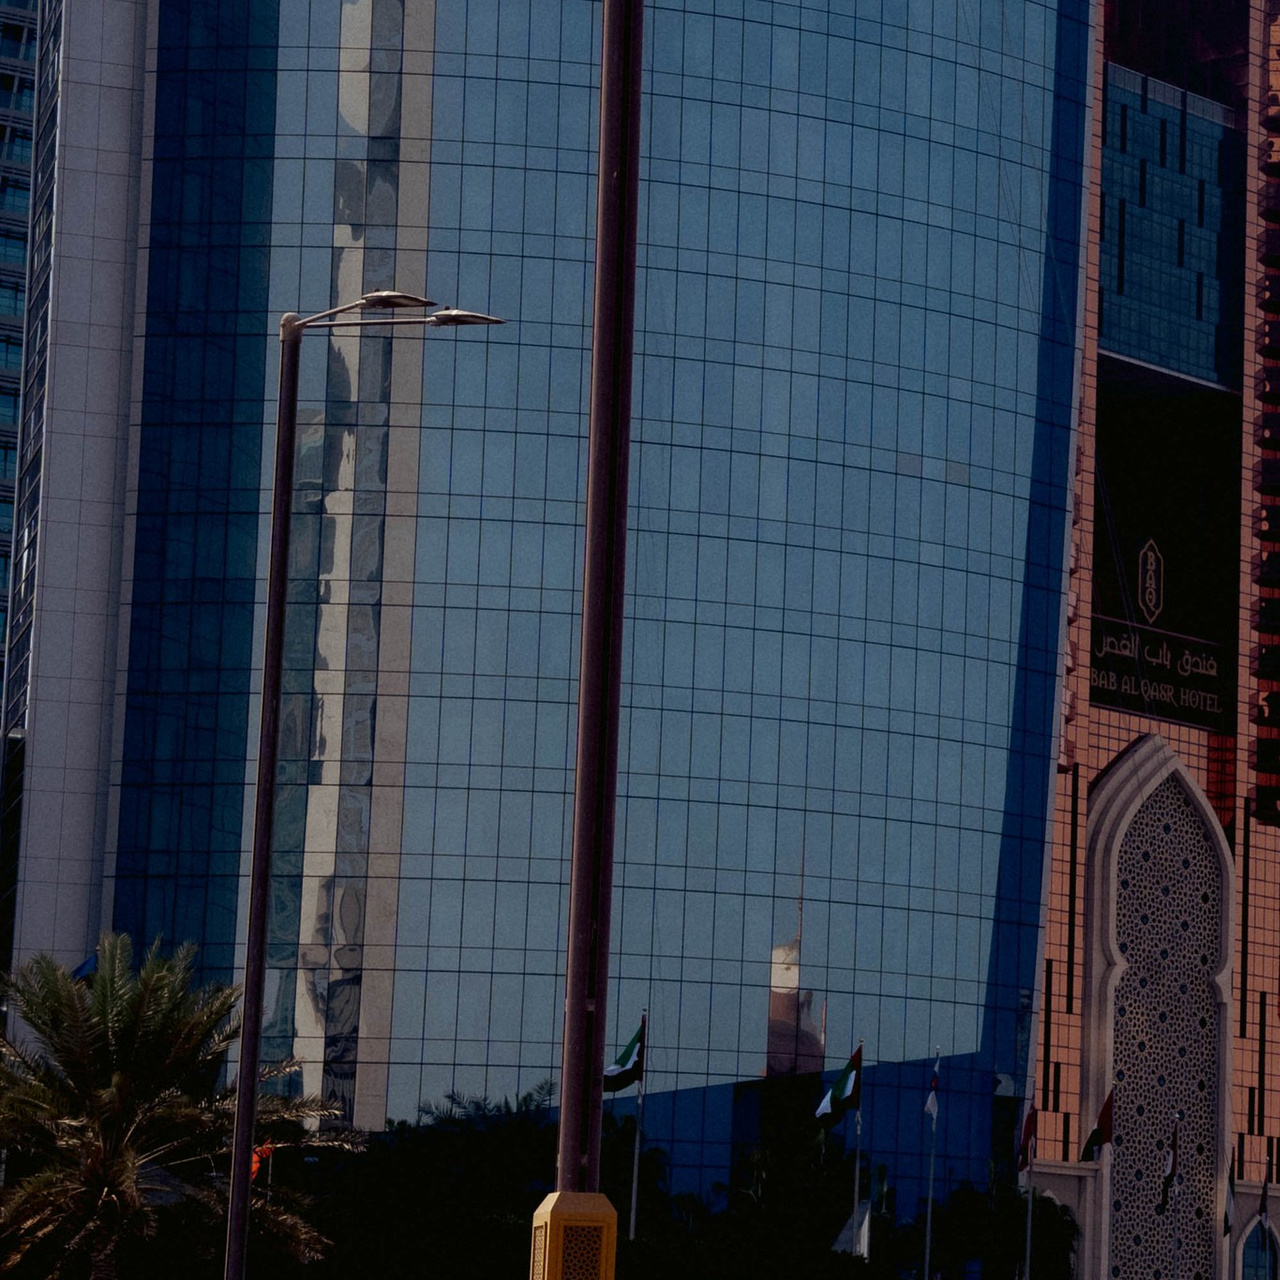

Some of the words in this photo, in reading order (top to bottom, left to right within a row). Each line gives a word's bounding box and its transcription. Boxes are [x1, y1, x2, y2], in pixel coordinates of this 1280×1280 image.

[1146, 551, 1156, 611] BAQ
[1095, 633, 1139, 657] القصر
[1145, 640, 1170, 668] باب
[1178, 650, 1217, 676] فندق
[1091, 668, 1117, 690] BAB
[1122, 676, 1140, 695] AL
[1141, 680, 1178, 707] QASR
[1181, 688, 1223, 713] HOTEL
